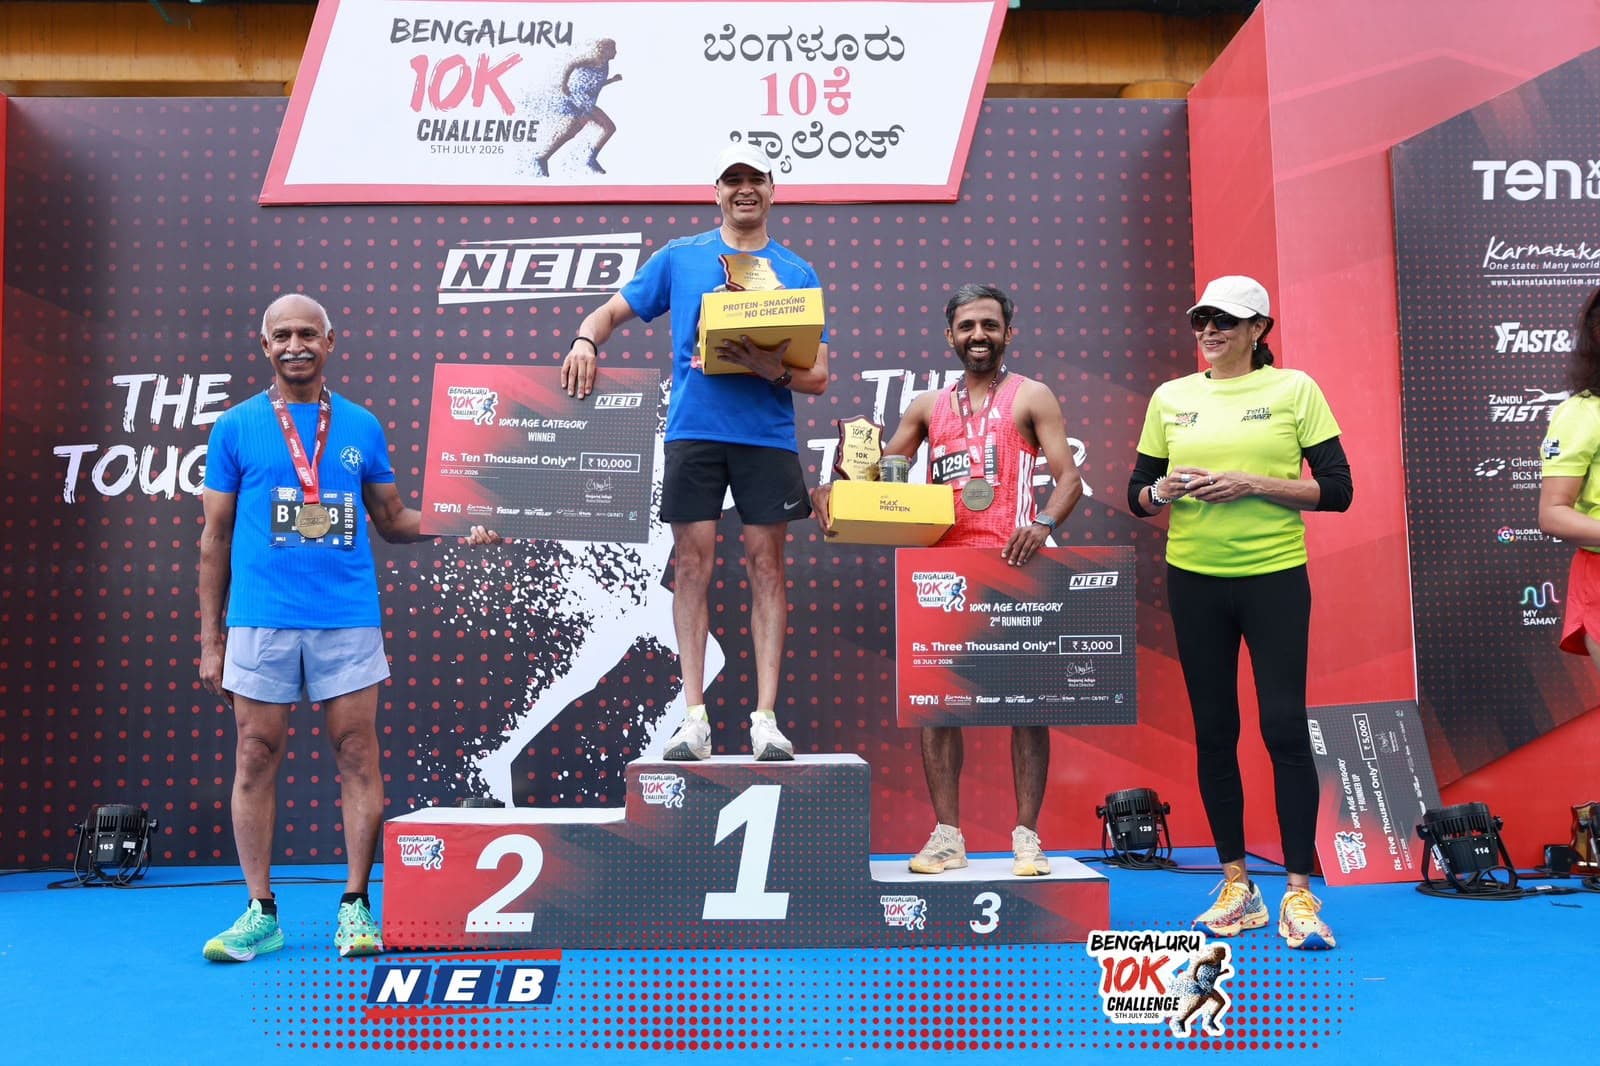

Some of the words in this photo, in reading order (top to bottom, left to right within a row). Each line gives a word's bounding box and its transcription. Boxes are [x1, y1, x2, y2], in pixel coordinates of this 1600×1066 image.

[390, 18, 573, 48] BENGALURU
[703, 23, 905, 62] ಬೆಂಗಳೂರು
[410, 53, 523, 116] 10K
[760, 66, 851, 116] 10ಕೆ
[417, 118, 540, 143] CHALLENGE
[430, 145, 450, 154] 5TH
[453, 145, 476, 155] JULY
[479, 145, 504, 154] 2026
[1483, 236, 1600, 268] Karnataka
[444, 250, 632, 289] NEB
[1489, 262, 1509, 270] One
[1543, 261, 1569, 272] Many
[744, 310, 758, 319] NO
[759, 305, 805, 317] CHEATING
[113, 374, 232, 432] THE
[452, 396, 475, 409] 10K
[596, 396, 641, 406] NEB
[862, 368, 966, 426] TH
[1489, 394, 1523, 405] ZANDU
[1490, 406, 1545, 422] FAST
[499, 418, 519, 427] 10KM
[521, 418, 540, 428] AGE
[541, 419, 588, 430] CATEGORY
[528, 432, 556, 442] WINNER
[441, 452, 457, 462] Rs.
[461, 453, 480, 463] Ten
[484, 453, 538, 465] Thousand
[597, 458, 632, 469] 10,000
[941, 453, 971, 475] 1296
[1512, 471, 1532, 480] BGS
[343, 493, 353, 529] TOUGHER
[344, 531, 354, 546] 10K
[1071, 575, 1118, 587] NEB
[919, 582, 943, 596] 10K
[969, 603, 991, 613] 10KM
[993, 603, 1014, 612] AGE
[1015, 602, 1064, 613] CATEGORY
[1001, 616, 1031, 627] RUNNER
[1032, 616, 1043, 626] UP
[1523, 617, 1557, 626] SAMAY
[912, 642, 928, 652] Rs.
[931, 642, 963, 651] Three
[964, 642, 1019, 651] Thousand
[1081, 641, 1113, 651] 3,000
[1359, 719, 1370, 744] 5,000
[1352, 774, 1361, 783] UP
[643, 782, 665, 794] 10K
[1346, 795, 1358, 811] AGE
[1375, 790, 1393, 835] Thousand
[402, 844, 424, 856] 10K
[702, 785, 790, 920] 1
[1387, 837, 1398, 855] Five
[1474, 847, 1490, 855] 114
[465, 834, 544, 932] 2
[885, 904, 906, 916] 10K
[969, 892, 1002, 934] 3
